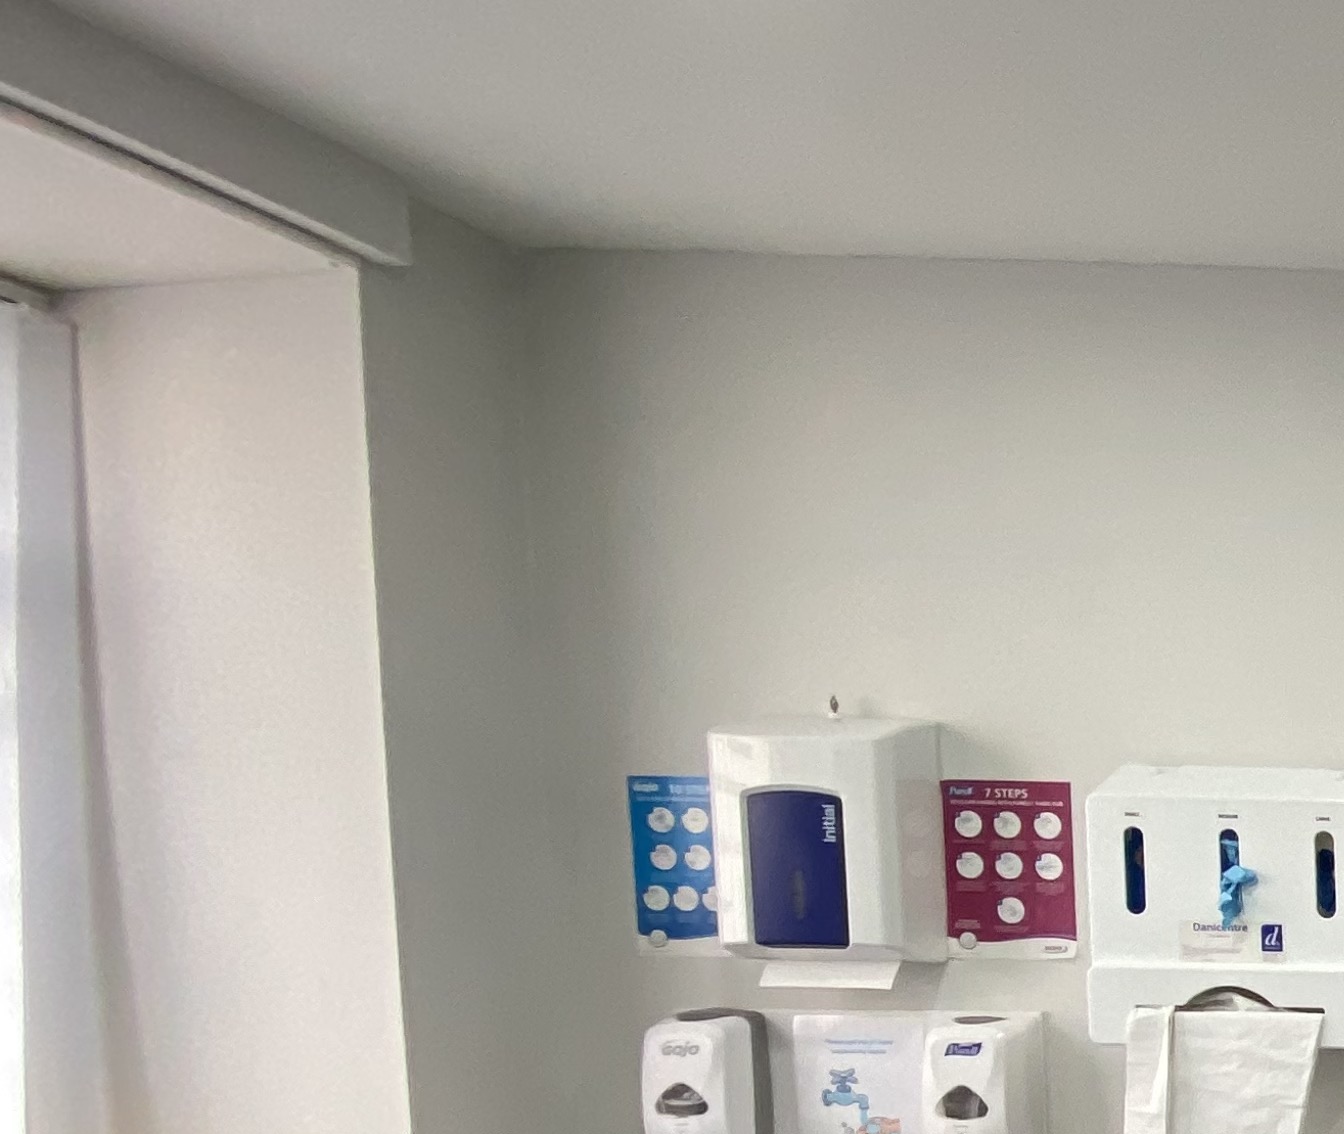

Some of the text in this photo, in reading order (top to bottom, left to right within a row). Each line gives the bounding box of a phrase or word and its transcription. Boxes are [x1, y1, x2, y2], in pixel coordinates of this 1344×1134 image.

[985, 788, 1029, 799] 7 STEPS
[1192, 922, 1248, 933] Danicntre
